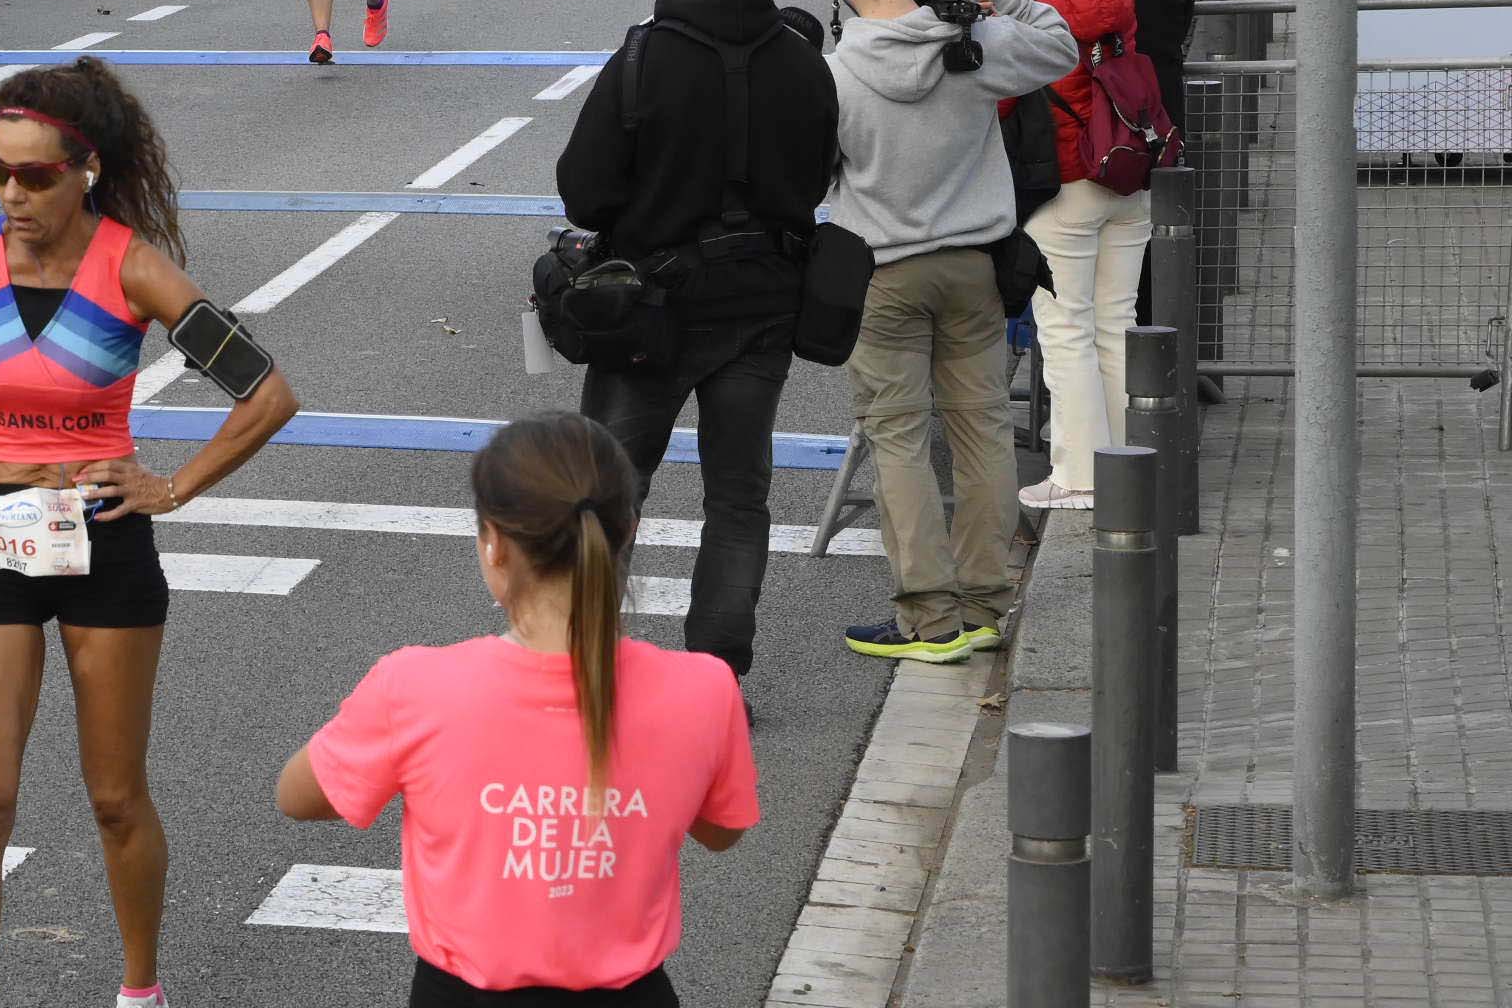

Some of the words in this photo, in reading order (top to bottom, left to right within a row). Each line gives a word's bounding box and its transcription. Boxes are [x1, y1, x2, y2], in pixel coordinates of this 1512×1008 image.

[513, 817, 559, 849] DE
[572, 818, 614, 849] LA
[503, 849, 617, 881] MUJER
